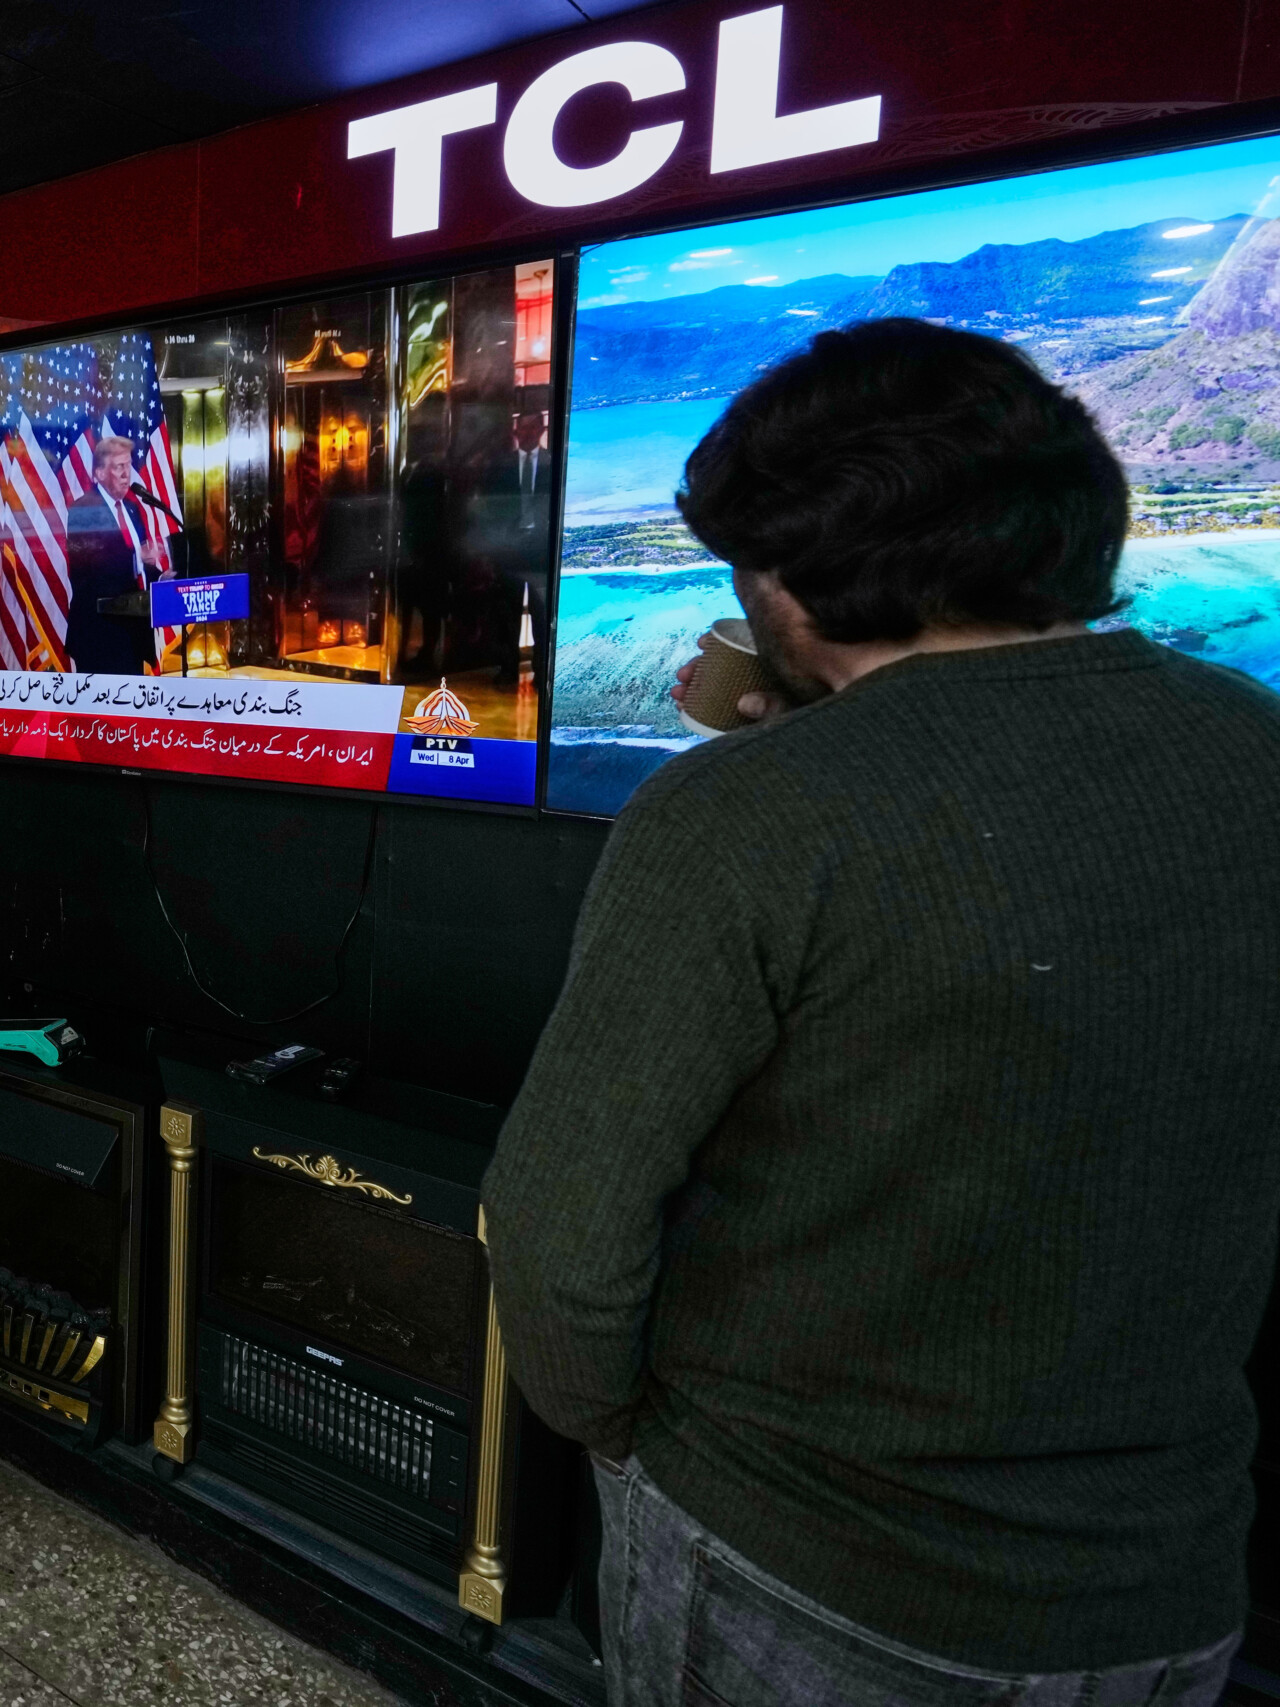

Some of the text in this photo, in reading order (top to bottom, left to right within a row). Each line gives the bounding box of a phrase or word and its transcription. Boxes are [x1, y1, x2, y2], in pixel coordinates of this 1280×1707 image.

[347, 4, 882, 239] TCL
[182, 590, 220, 605] TRUMP
[186, 601, 217, 614] VANCE
[19, 678, 51, 703] حاصل
[53, 673, 65, 704] فتح
[66, 673, 94, 705] مکمل
[92, 688, 110, 705] بعد
[112, 683, 131, 705] کے
[133, 685, 163, 709] اتفاق
[164, 695, 175, 716] پر
[176, 692, 232, 714] معاہدے
[233, 691, 267, 715] بندی
[269, 688, 302, 716] جنگ
[48, 719, 68, 741] ایک
[97, 723, 107, 740] کا
[106, 723, 139, 751] پاکستان
[141, 727, 159, 747] میں
[162, 729, 188, 748] بندی
[190, 727, 216, 751] جنگ
[263, 734, 284, 755] کے
[287, 734, 326, 762] امریکہ
[426, 738, 458, 750] PTV
[418, 752, 470, 766] Wed 8 Apr
[413, 1395, 455, 1417] DO NOT COVER
